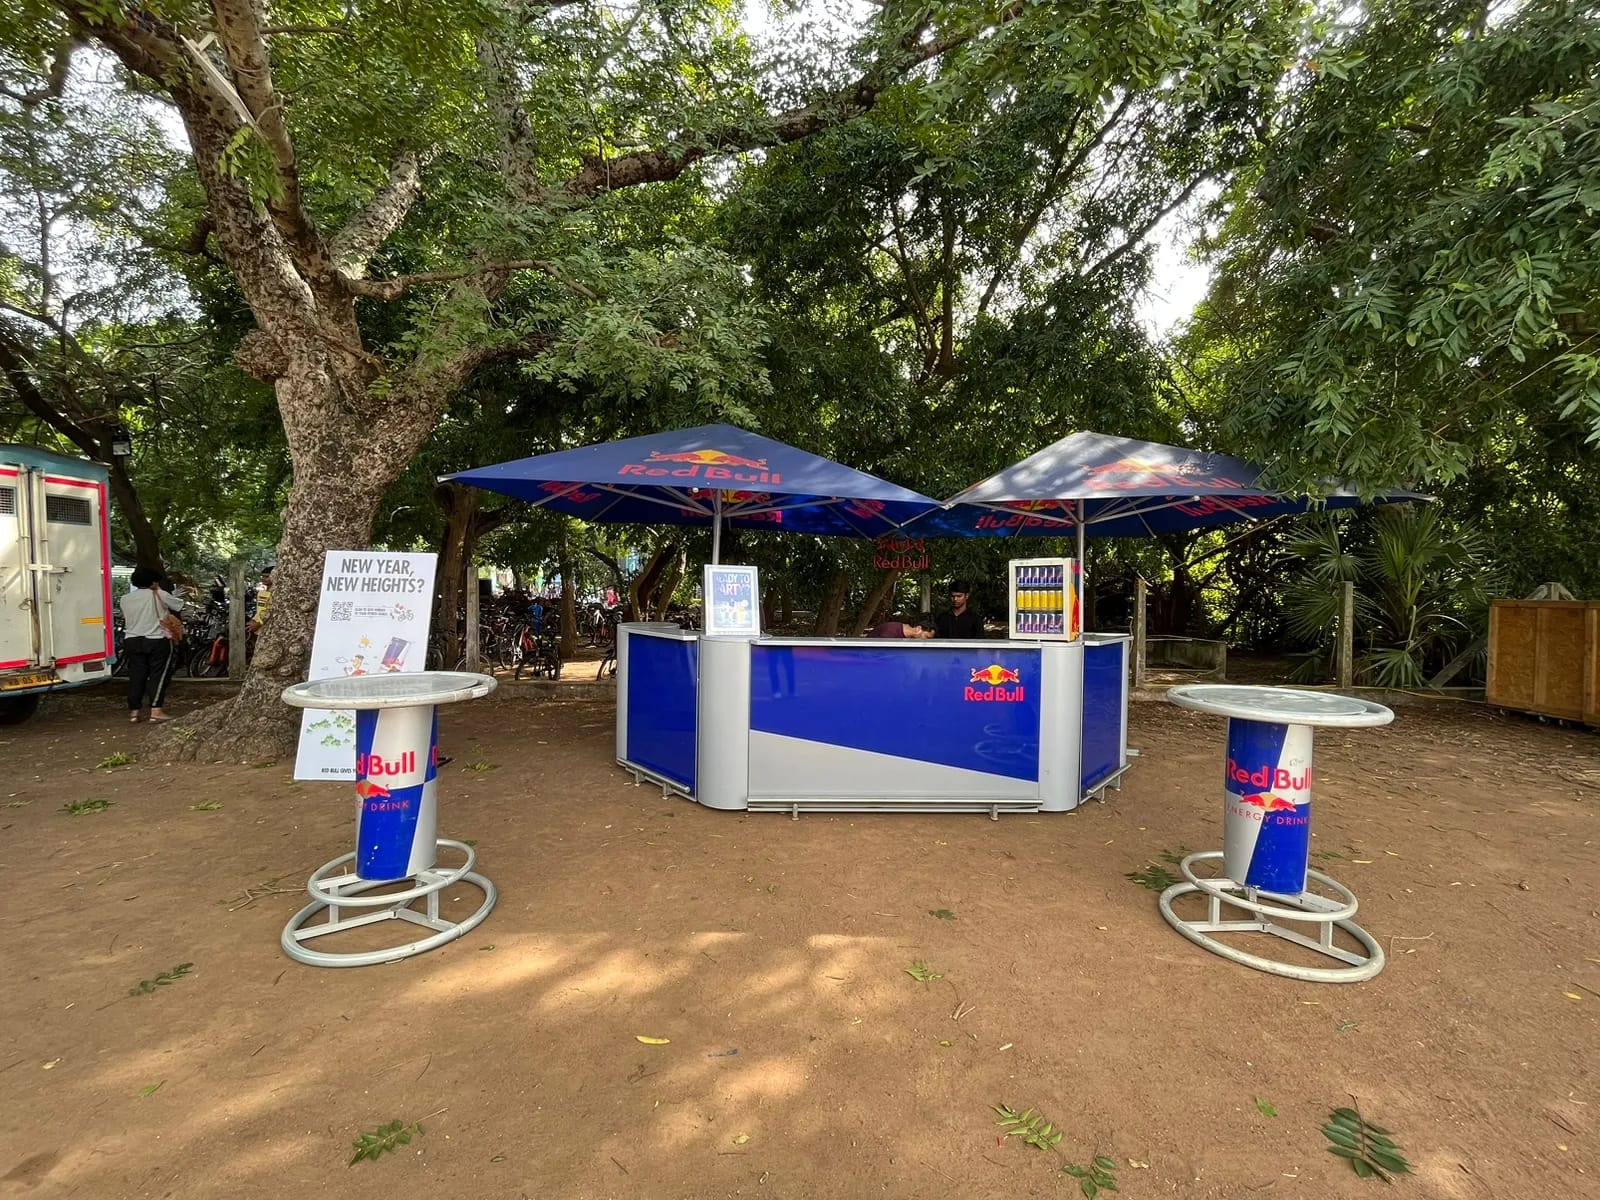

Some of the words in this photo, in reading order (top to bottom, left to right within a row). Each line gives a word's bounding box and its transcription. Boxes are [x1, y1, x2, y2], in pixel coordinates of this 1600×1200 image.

[617, 464, 699, 478] Red
[703, 466, 782, 484] Bull
[341, 558, 373, 574] NEW
[376, 559, 414, 577] YEAR,
[873, 555, 900, 569] Red
[902, 554, 929, 569] Bull
[326, 576, 359, 592] NEW
[360, 577, 425, 593] HEIGHTS?
[739, 574, 750, 584] TO
[964, 686, 994, 701] Red
[996, 686, 1024, 701] Bull
[367, 751, 415, 776] Bull
[1227, 758, 1269, 788] Red
[1273, 767, 1312, 791] Bull
[370, 800, 410, 812] DRINK
